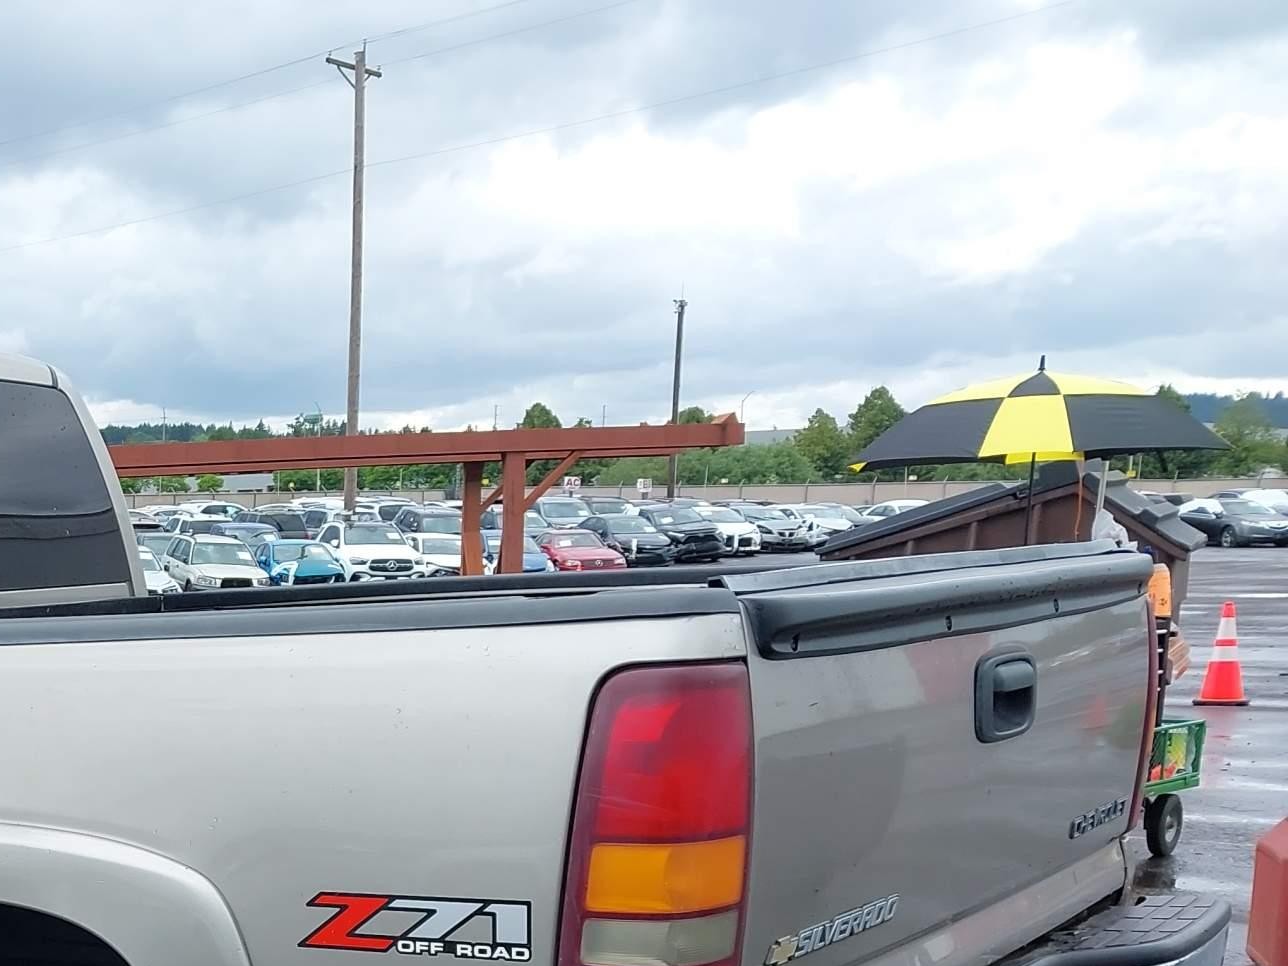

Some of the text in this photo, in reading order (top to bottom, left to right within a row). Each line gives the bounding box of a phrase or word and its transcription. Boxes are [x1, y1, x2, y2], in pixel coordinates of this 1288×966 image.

[297, 891, 532, 952] Z71
[396, 938, 531, 961] OFF ROAD
[794, 894, 900, 957] SILVERADO
